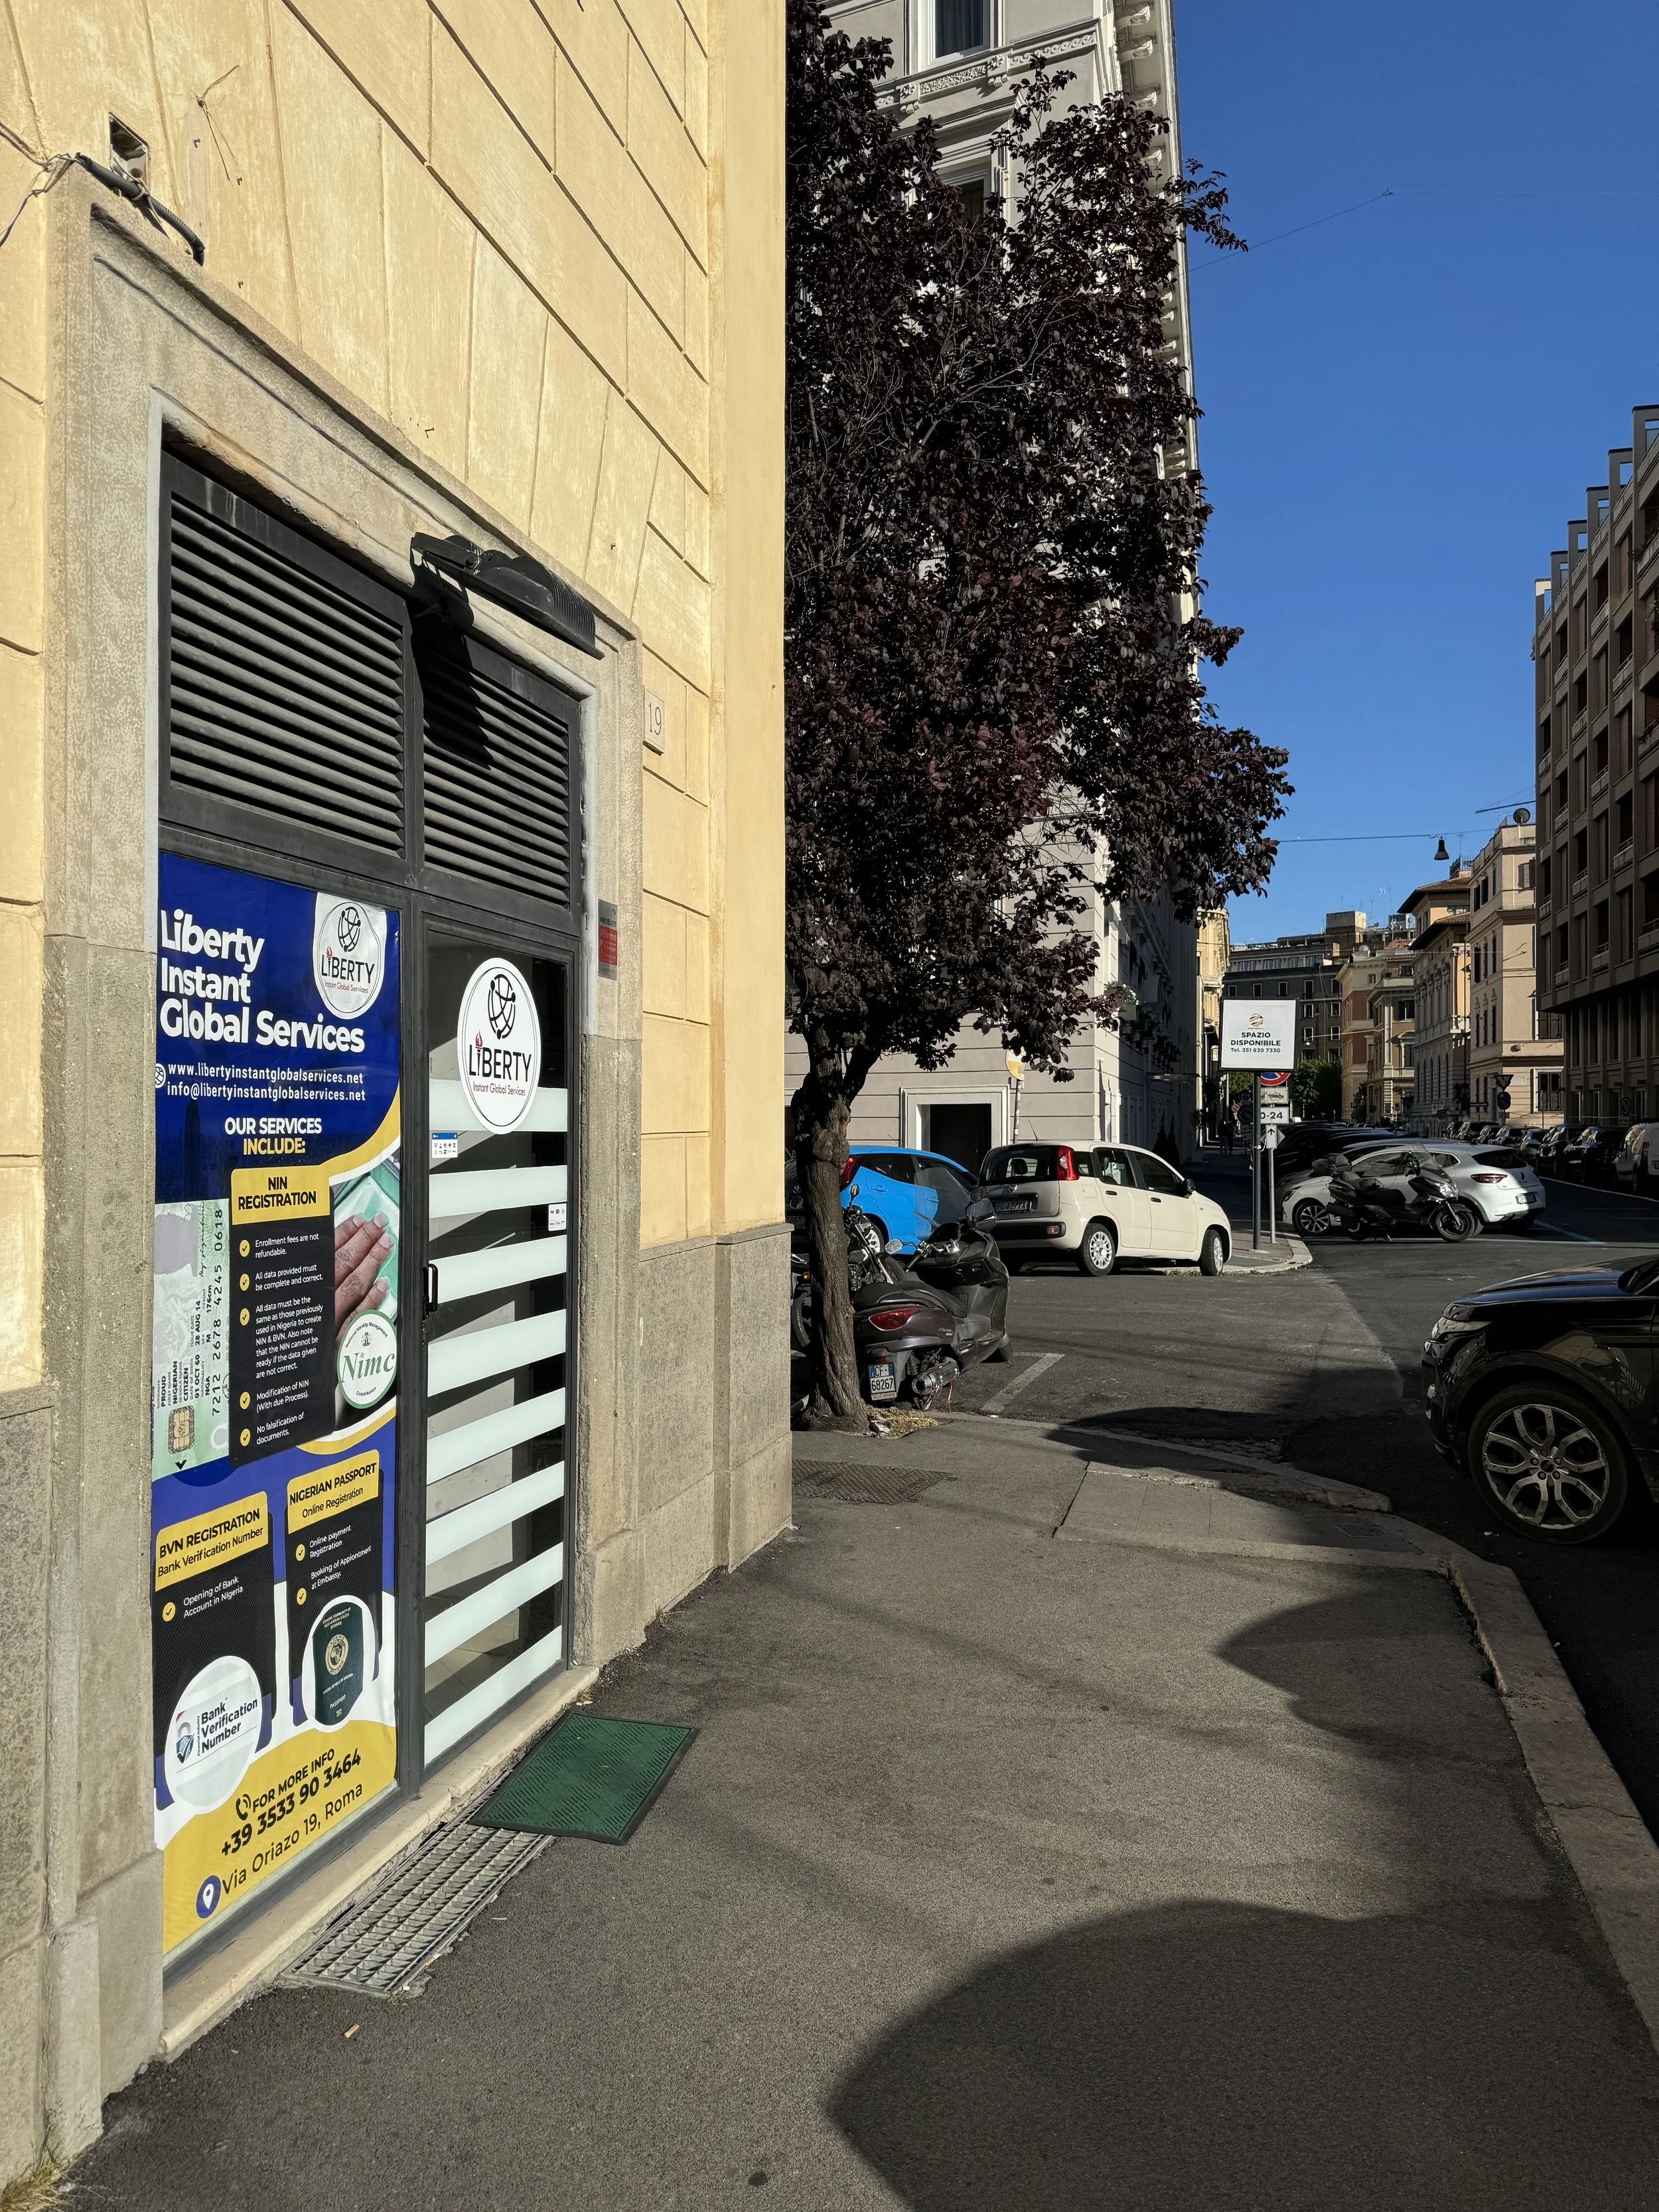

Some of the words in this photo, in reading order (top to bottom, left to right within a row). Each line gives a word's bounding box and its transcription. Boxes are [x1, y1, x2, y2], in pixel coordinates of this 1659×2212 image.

[648, 702, 662, 735] 19
[161, 909, 265, 972] Liberty
[162, 958, 250, 1003] Instant
[160, 998, 250, 1043] Global
[256, 1010, 365, 1053] Services
[168, 1063, 363, 1084] www.libertyinstantglobalservices.net
[167, 1082, 366, 1102] info@libertyinstantglobalservices.net
[473, 1082, 488, 1092] Instant
[490, 1083, 506, 1094] Global
[508, 1085, 526, 1096] Services
[224, 1117, 255, 1135] OUR
[259, 1118, 322, 1134] SERVICES
[243, 1138, 306, 1155] INCLUDE:
[268, 1177, 287, 1190] NIN
[238, 1191, 316, 1210] REGISTRATION
[214, 1209, 223, 1251] 0618
[255, 1237, 286, 1247] Enrollment
[255, 1248, 287, 1258] refundable.
[264, 1279, 289, 1289] complete
[303, 1274, 323, 1283] correct.
[277, 1266, 301, 1278] provided
[195, 1301, 200, 1311] 14
[255, 1315, 271, 1324] same
[279, 1310, 295, 1319] those
[296, 1304, 324, 1317] previously
[277, 1300, 292, 1309] must
[255, 1326, 269, 1335] used
[277, 1320, 297, 1331] Nigeria
[305, 1315, 322, 1324] create
[273, 1333, 287, 1342] BVN.
[300, 1327, 313, 1336] note
[195, 1333, 200, 1346] 28
[206, 1334, 210, 1343] M
[269, 1345, 278, 1354] the
[291, 1339, 310, 1349] cannot
[195, 1354, 200, 1365] 60
[256, 1358, 272, 1368] ready
[301, 1347, 317, 1358] given
[277, 1362, 298, 1372] correct.
[342, 1352, 395, 1383] Nimc
[195, 1388, 200, 1398] 01
[212, 1373, 220, 1416] 7212
[257, 1386, 291, 1400] Modification
[299, 1379, 309, 1388] NIN
[871, 1378, 893, 1391] 68267
[256, 1402, 272, 1414] (With
[285, 1390, 309, 1403] Process).
[266, 1416, 297, 1430] falsification
[257, 1429, 289, 1445] documents.
[289, 1479, 332, 1505] NIGERIAN
[334, 1462, 376, 1489] PASSPORT
[302, 1503, 324, 1518] Online
[326, 1487, 363, 1511] Registration
[159, 1538, 183, 1559] BVN
[186, 1508, 260, 1548] REGISTRATION
[309, 1534, 327, 1548] Online
[328, 1525, 351, 1541] payment
[158, 1559, 180, 1578] Bank
[182, 1541, 231, 1566] Verification
[232, 1527, 263, 1547] Number
[310, 1540, 342, 1559] Registration
[311, 1564, 332, 1580] Booking
[333, 1560, 339, 1569] of
[183, 1588, 213, 1606] Opening
[214, 1582, 222, 1592] of
[222, 1576, 238, 1589] Bank
[184, 1599, 212, 1618] Account
[214, 1595, 220, 1605] in
[201, 1702, 226, 1725] Bank
[201, 1698, 257, 1738] Verification
[202, 1722, 242, 1753] Number
[253, 1789, 275, 1813] FOR
[278, 1765, 308, 1796] MORE
[311, 1748, 334, 1773] INFO
[222, 1823, 252, 1856] +39
[257, 1793, 295, 1836] 3533
[299, 1777, 319, 1805] 90
[323, 1747, 361, 1789] 3464
[222, 1868, 246, 1895] Via
[252, 1830, 299, 1873] Oriazo
[303, 1813, 321, 1836] 19,
[325, 1783, 362, 1820] Roma
